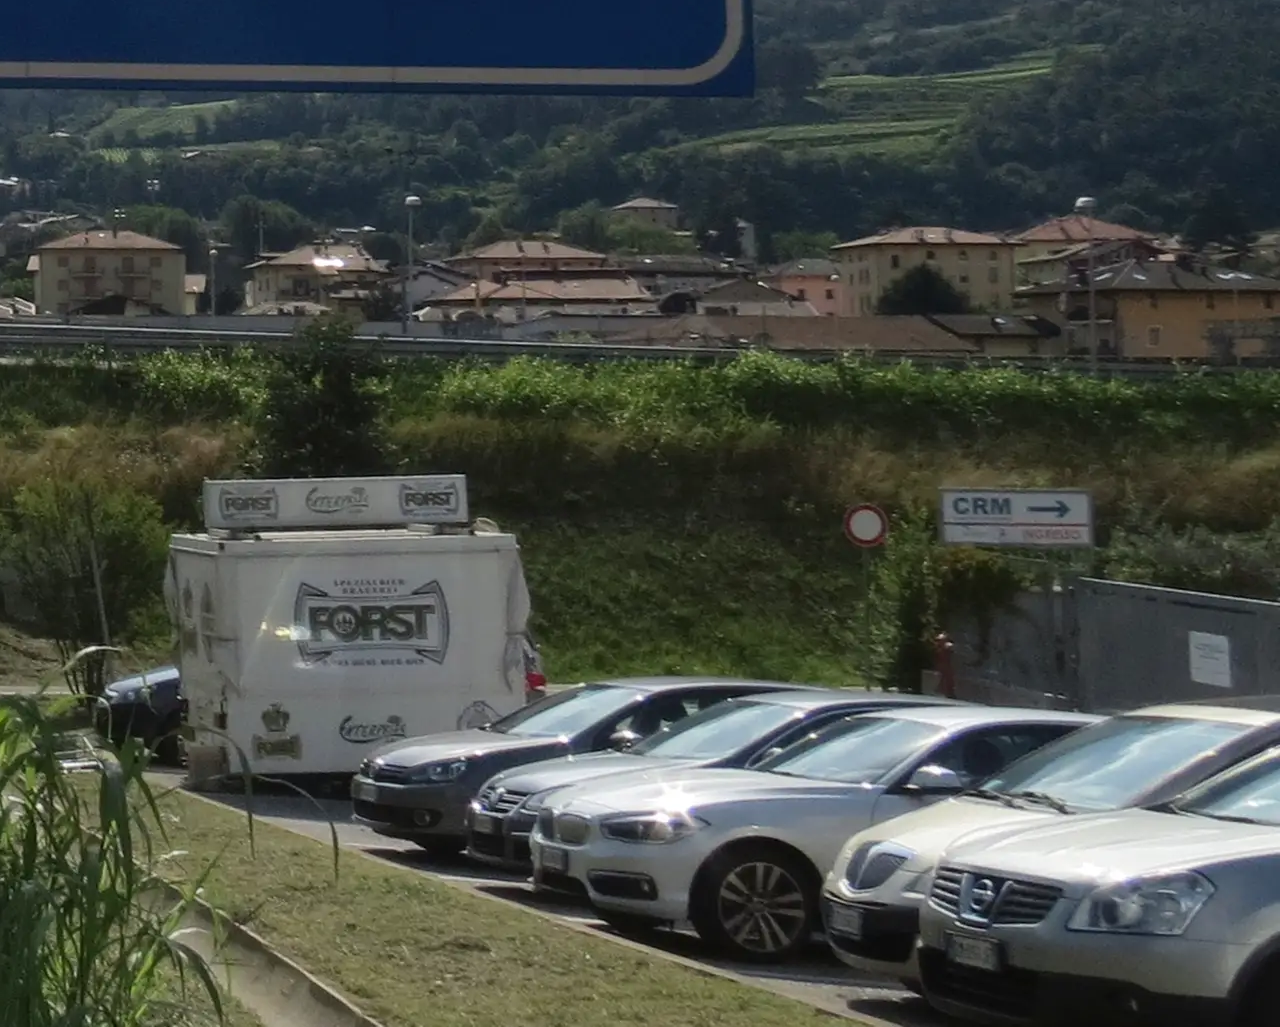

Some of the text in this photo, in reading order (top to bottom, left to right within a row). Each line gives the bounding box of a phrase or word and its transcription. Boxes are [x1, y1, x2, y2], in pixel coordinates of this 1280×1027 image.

[404, 491, 454, 507] FORST
[952, 497, 1012, 515] CRM
[308, 604, 436, 643] FORST
